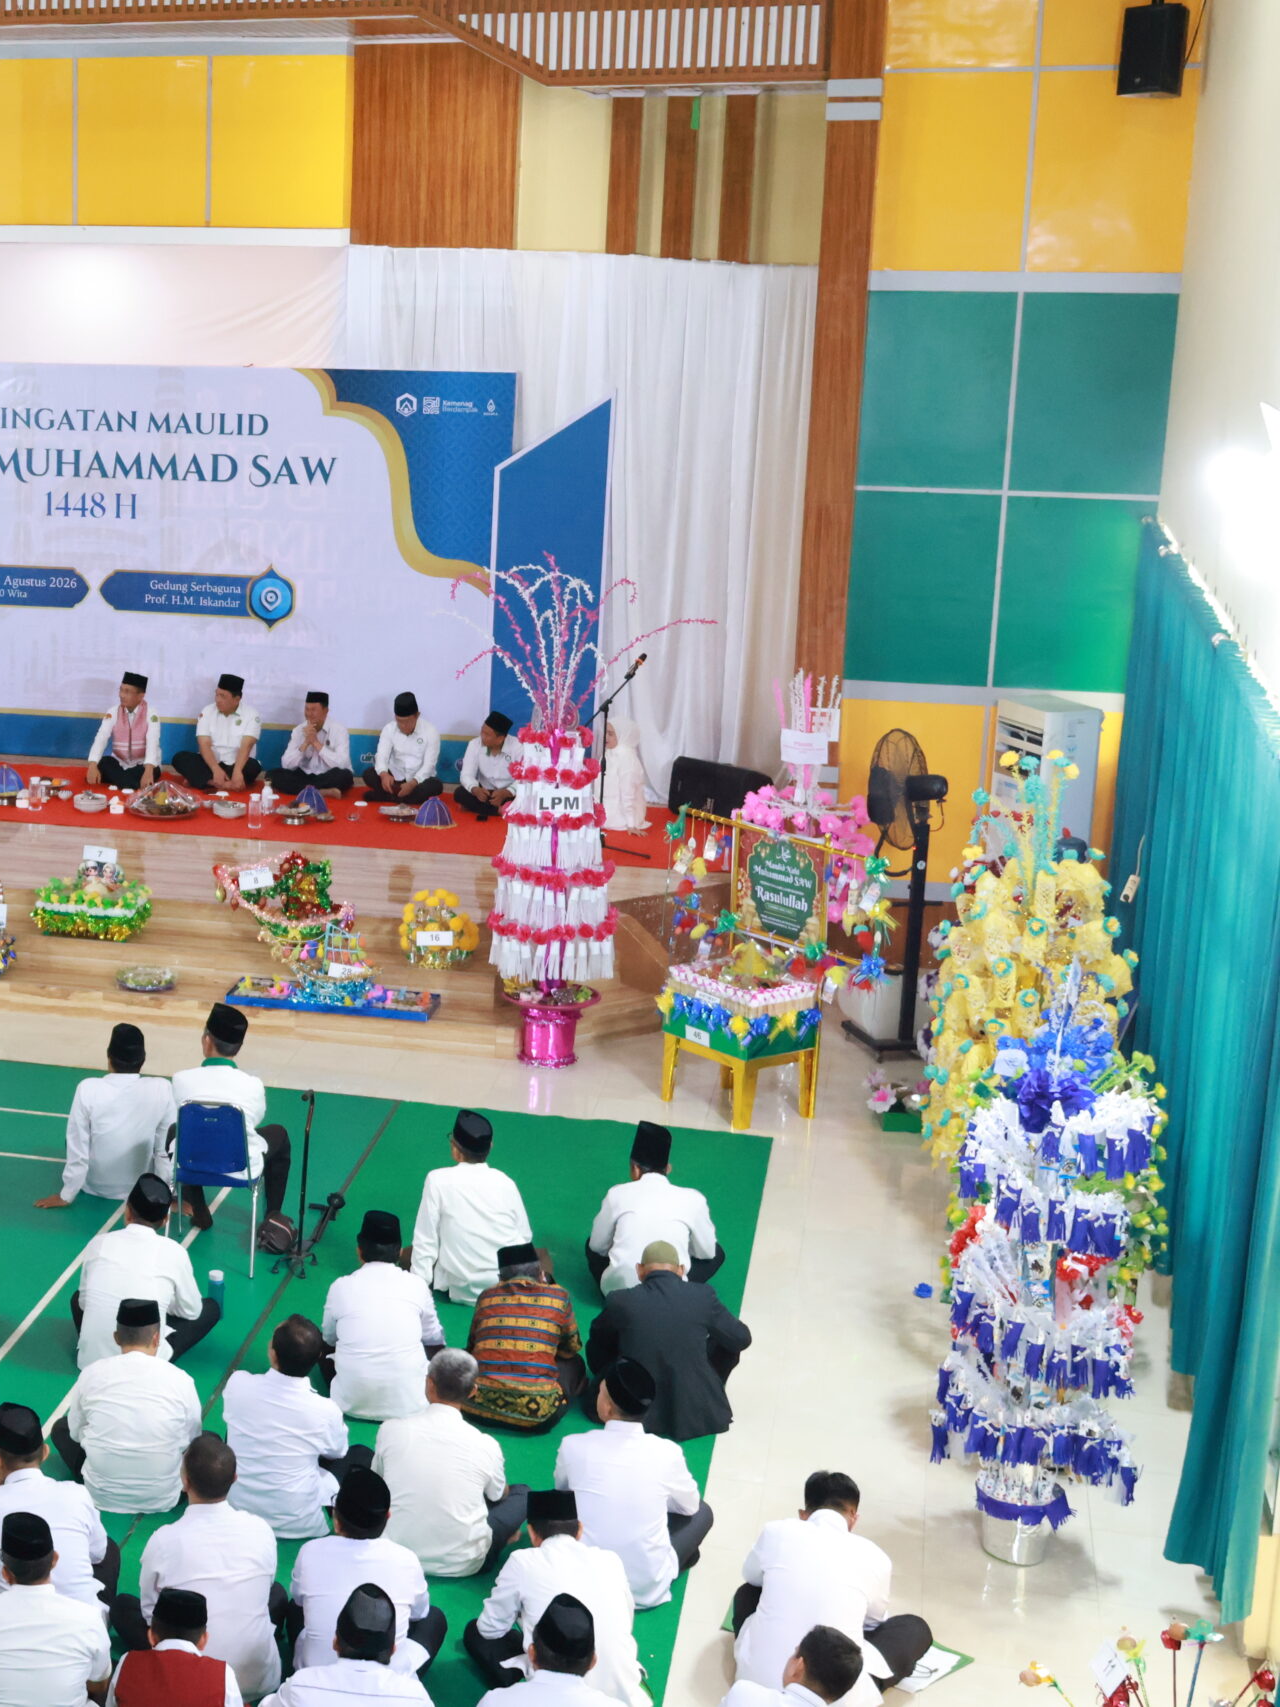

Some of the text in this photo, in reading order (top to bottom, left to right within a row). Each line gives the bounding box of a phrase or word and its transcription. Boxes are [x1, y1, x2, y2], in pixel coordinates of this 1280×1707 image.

[147, 411, 269, 436] MAULID
[249, 454, 337, 488] SAW
[46, 491, 137, 520] 1448 H
[4, 575, 47, 588] Agustus
[49, 577, 77, 588] 2026
[150, 580, 241, 595] Gedung Serbaguna
[7, 589, 27, 598] Wita
[144, 594, 240, 608] Prof. H.M. Iskandar
[538, 796, 580, 811] LPM
[753, 865, 794, 884] Muhammad
[794, 876, 813, 889] SAW
[755, 885, 808, 913] Rasulullah
[430, 934, 440, 942] 16
